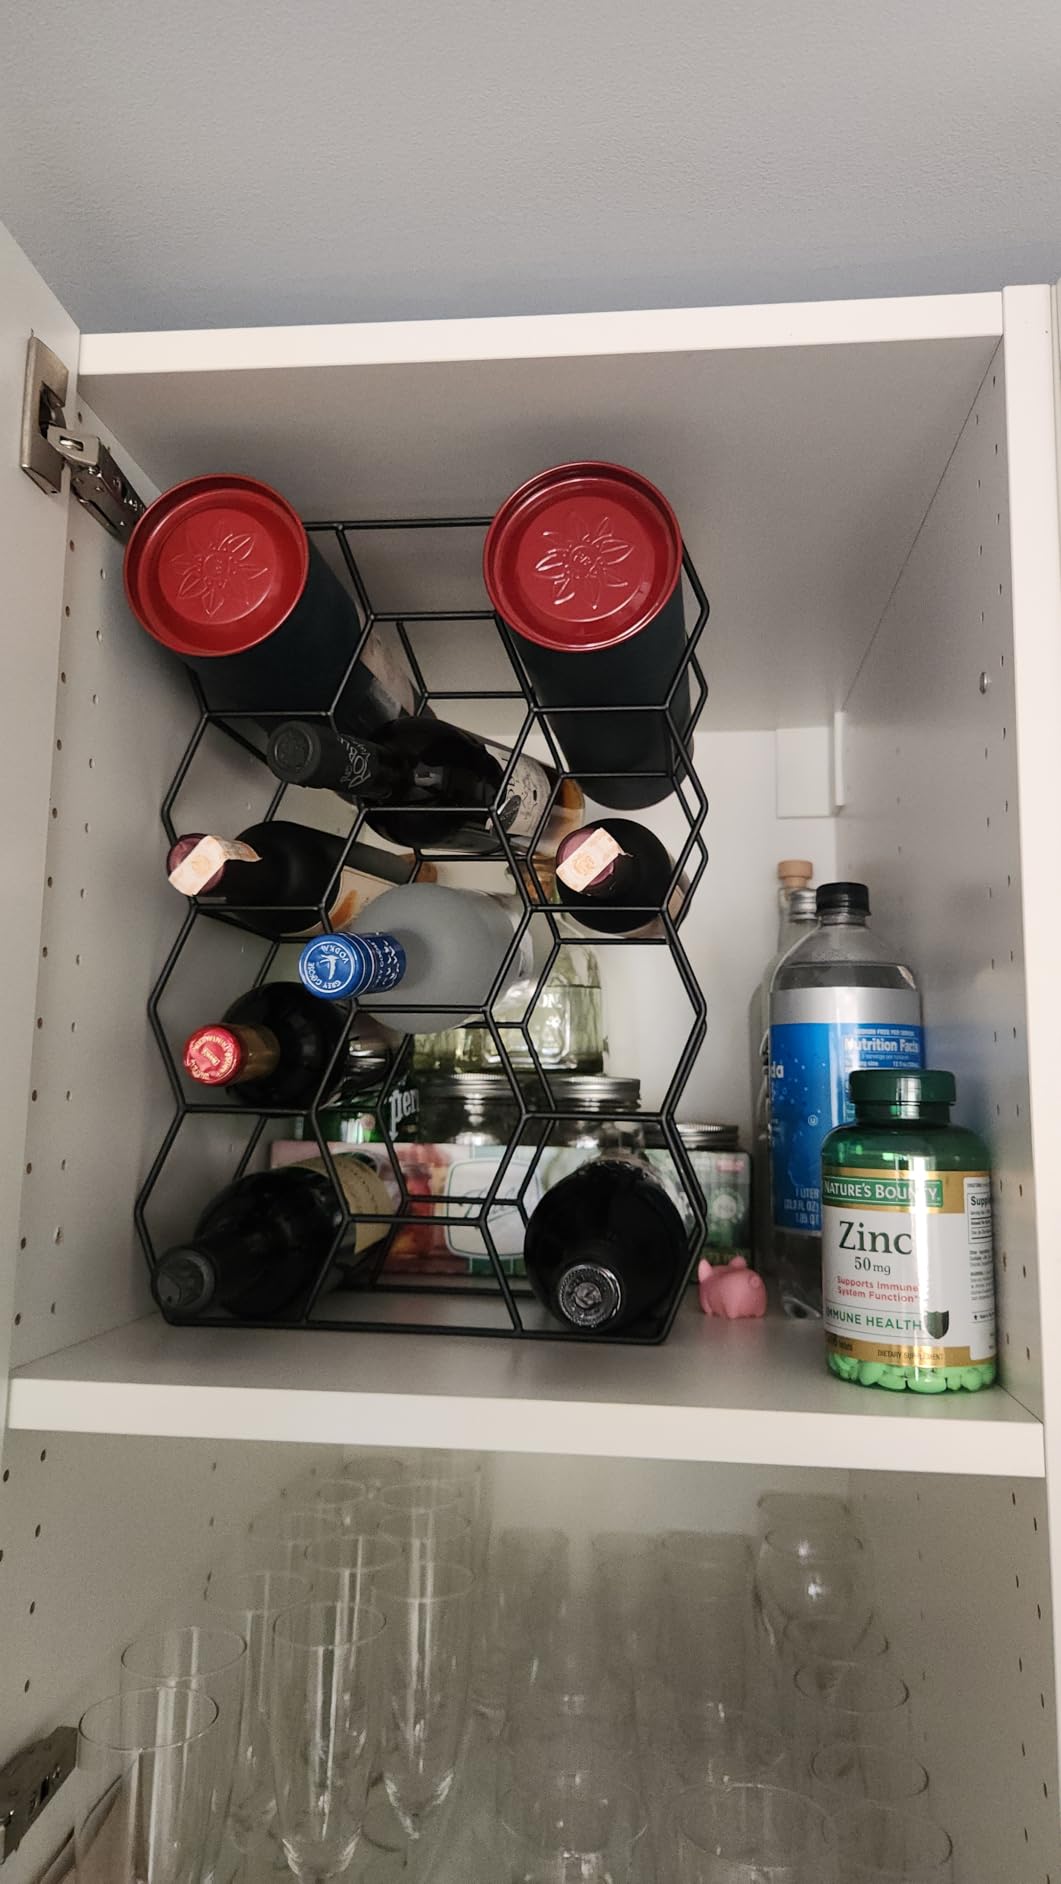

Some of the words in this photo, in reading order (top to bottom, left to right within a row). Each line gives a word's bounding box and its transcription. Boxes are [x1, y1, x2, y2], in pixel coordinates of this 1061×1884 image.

[320, 943, 350, 964] VODKA
[307, 961, 323, 986] GOOSE
[322, 979, 342, 990] GREY
[844, 1037, 898, 1052] Nutrition
[899, 1038, 919, 1053] Facts
[824, 1180, 873, 1198] NATURE'S
[838, 1220, 913, 1255] Zinc
[854, 1256, 872, 1272] 50
[873, 1263, 891, 1276] mg
[837, 1276, 874, 1289] Supports
[877, 1281, 919, 1292] Immune
[838, 1286, 866, 1298] System
[866, 1315, 922, 1331] HEALTH
[877, 1349, 902, 1358] DIETARY
